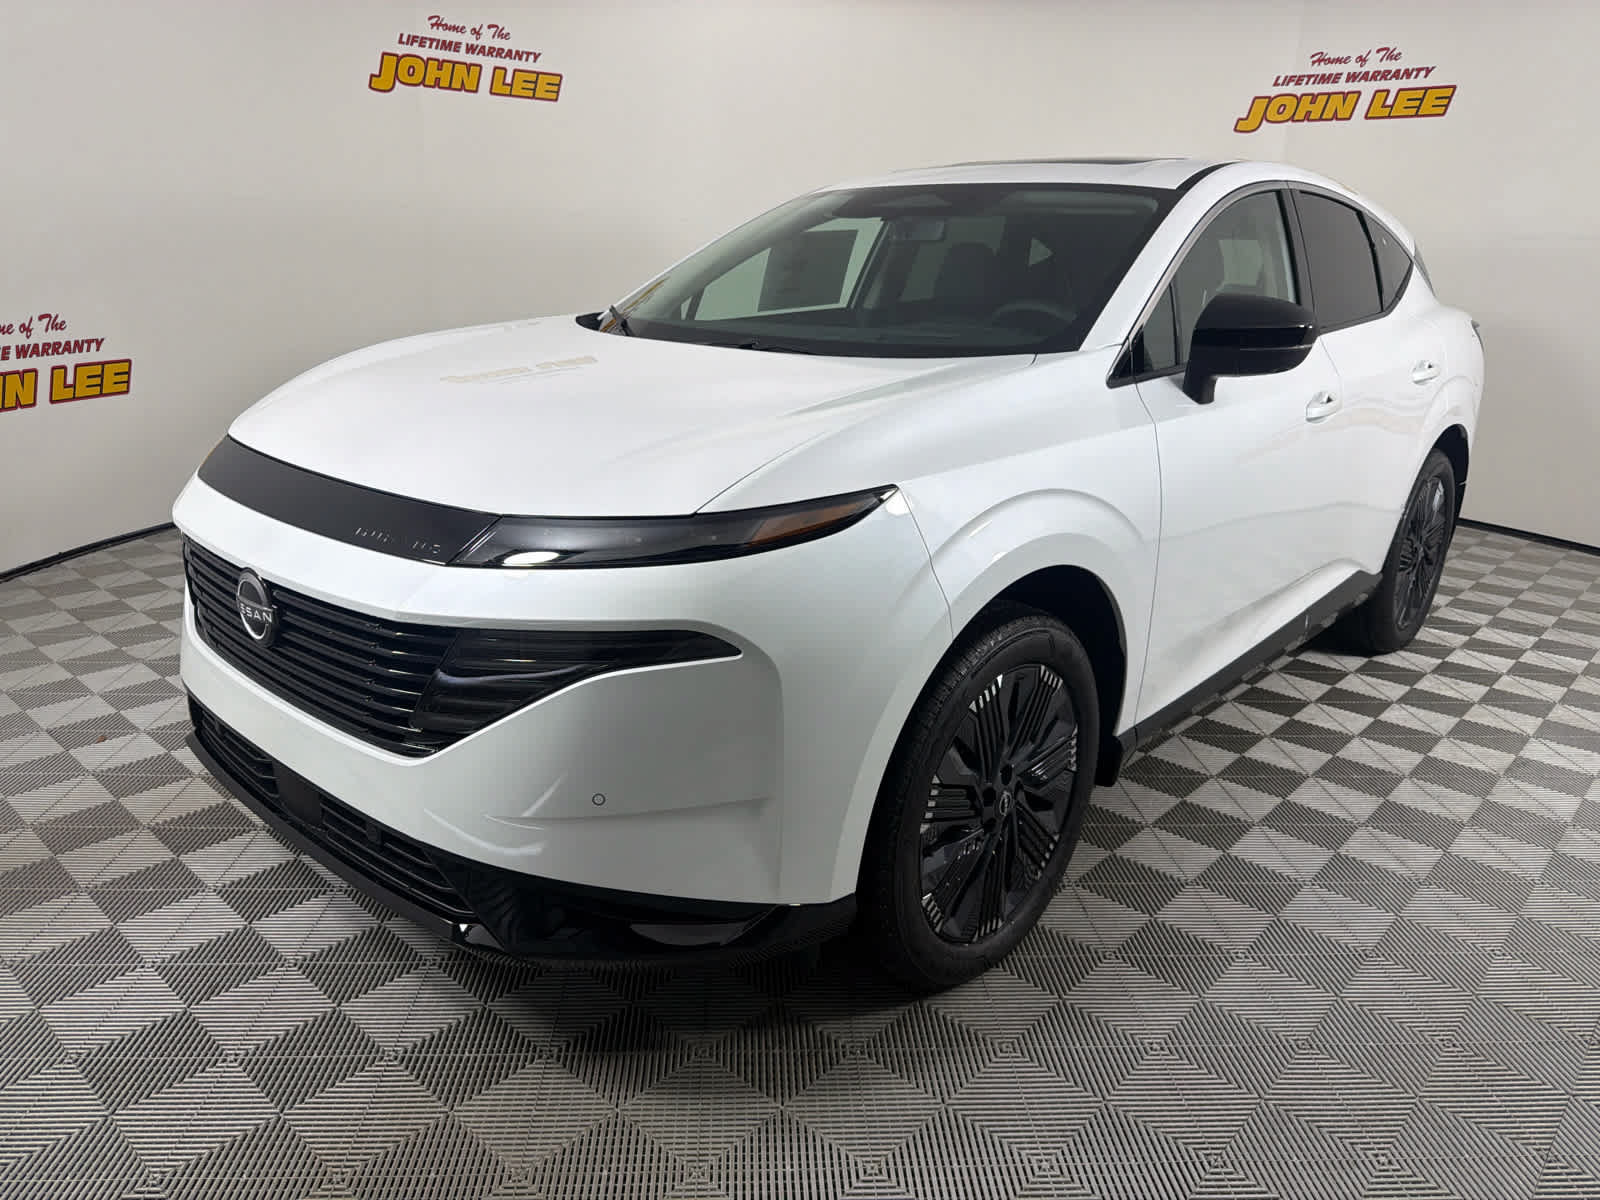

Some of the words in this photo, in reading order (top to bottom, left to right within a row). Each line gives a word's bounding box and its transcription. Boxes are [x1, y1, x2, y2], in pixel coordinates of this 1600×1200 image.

[428, 15, 467, 34] Home
[470, 23, 484, 41] of
[487, 23, 511, 41] The
[398, 32, 462, 53] LIFETIME
[465, 43, 542, 63] WARRANTY
[1310, 51, 1351, 67] Home
[1355, 49, 1371, 68] of
[1376, 47, 1402, 63] The
[368, 51, 483, 93] JOHN
[489, 66, 563, 102] LEE
[1272, 72, 1343, 87] LIFETIME
[1345, 66, 1436, 84] WARRANTY
[1233, 90, 1362, 133] JOHN
[1364, 84, 1457, 120] LEE
[19, 316, 34, 339] of
[38, 313, 67, 333] The
[15, 338, 105, 359] WARRANTY
[49, 358, 132, 404] LEE
